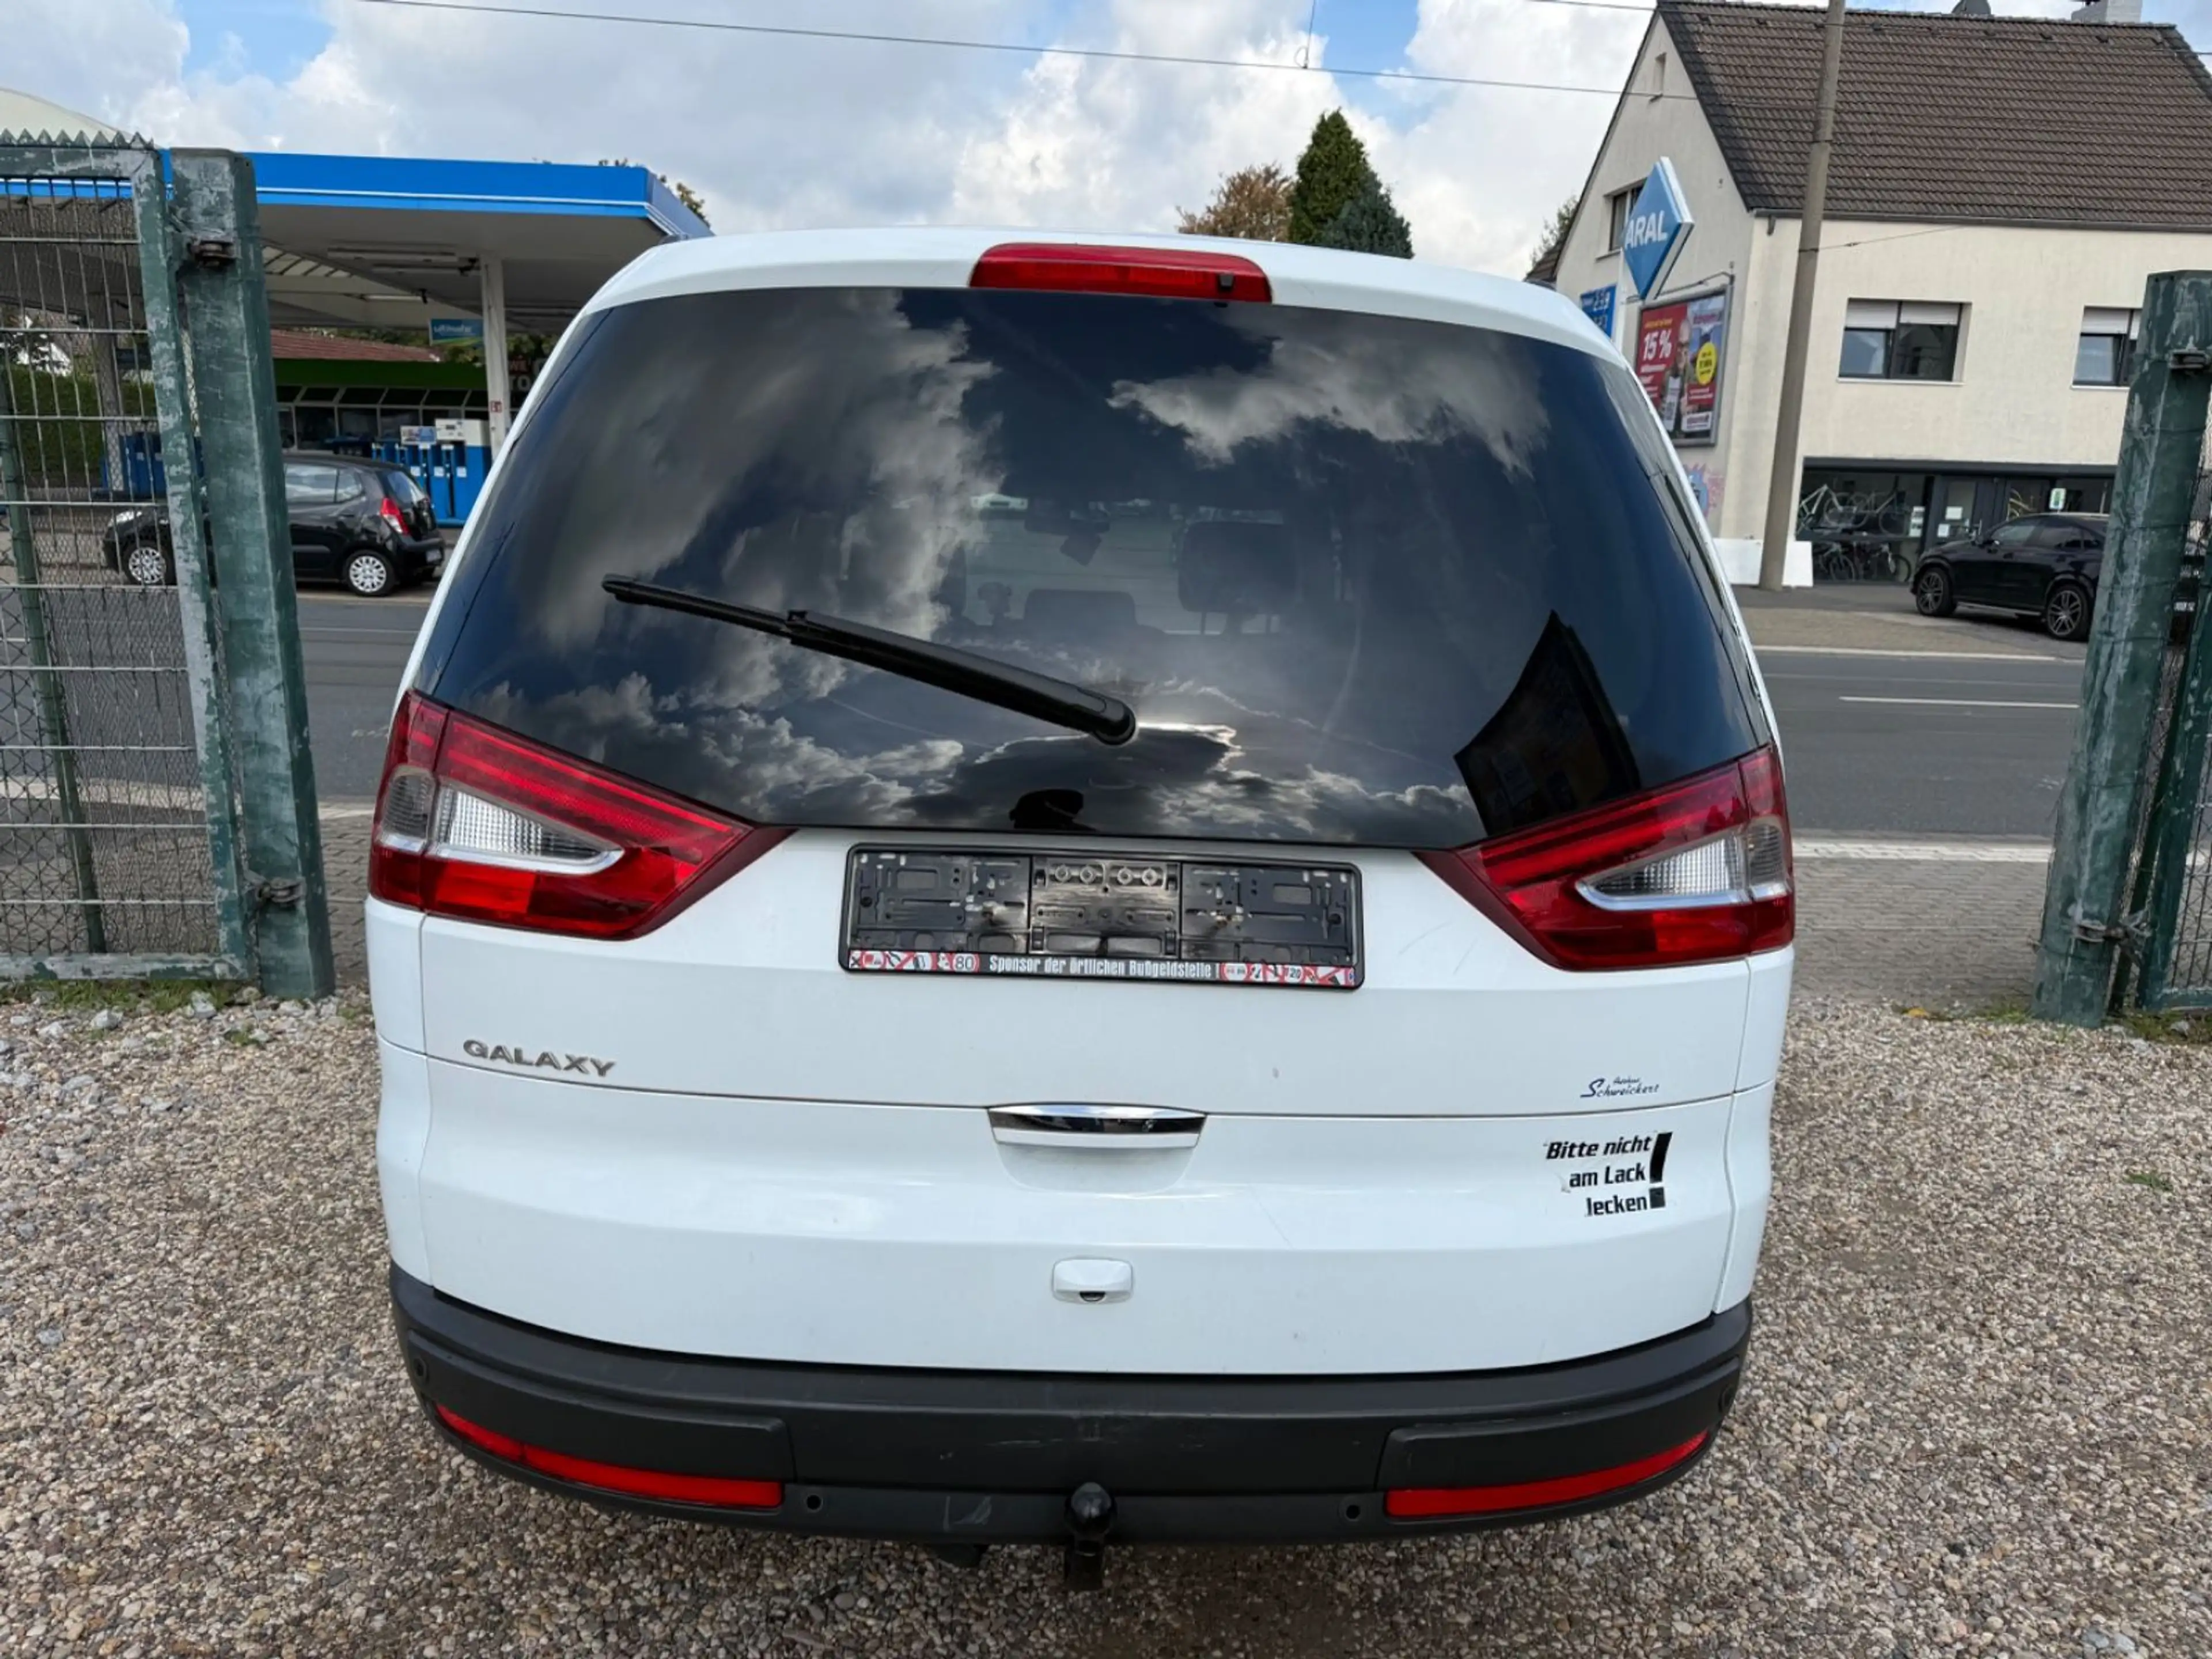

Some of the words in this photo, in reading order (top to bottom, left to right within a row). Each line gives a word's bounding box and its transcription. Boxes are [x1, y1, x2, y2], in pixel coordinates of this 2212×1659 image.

[1624, 210, 1668, 250] ARAL
[955, 955, 974, 970] 80
[990, 954, 1040, 973] Sponsor
[1044, 957, 1066, 974] der
[463, 1039, 616, 1077] GALAXY
[1546, 1141, 1599, 1160] Bitte
[1603, 1134, 1652, 1156] nicht
[1569, 1171, 1598, 1188] am
[1604, 1162, 1646, 1185] Lack
[1585, 1194, 1647, 1217] lecken
